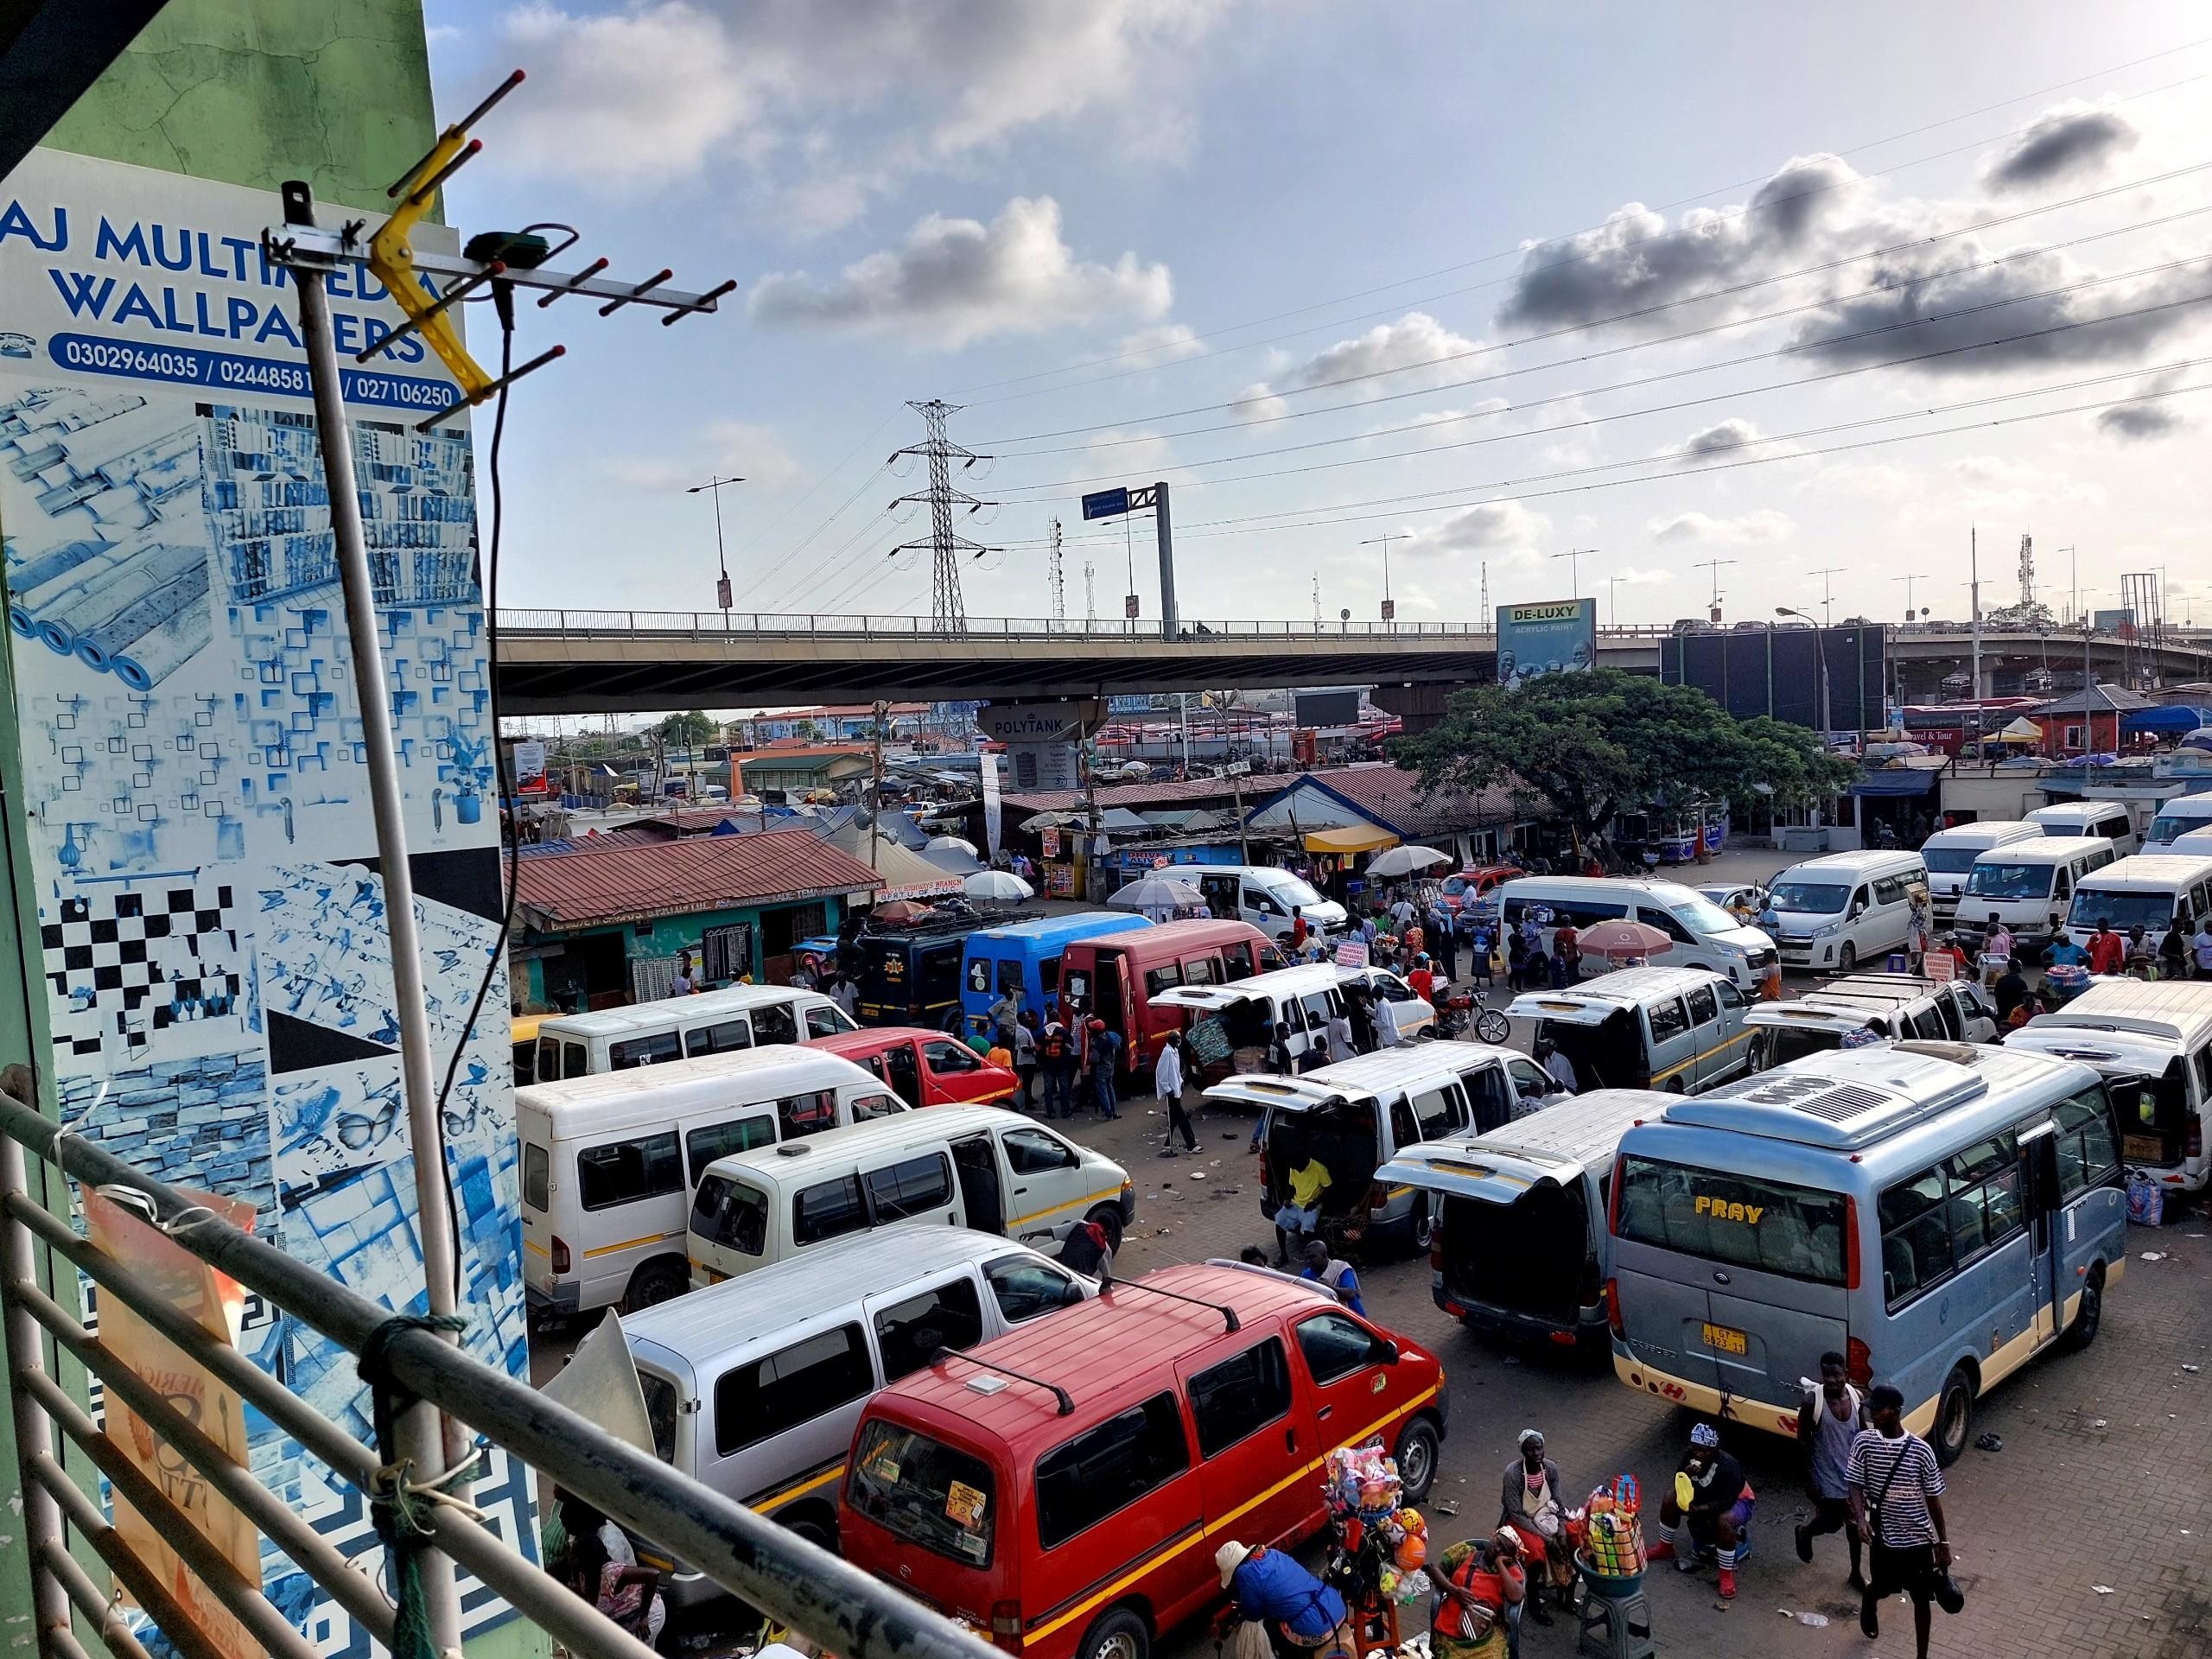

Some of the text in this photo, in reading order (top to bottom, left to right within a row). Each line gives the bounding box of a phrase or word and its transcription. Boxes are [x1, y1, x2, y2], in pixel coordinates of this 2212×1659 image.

[0, 199, 68, 252] AJ
[48, 269, 424, 362] WALLPAERS
[67, 341, 198, 378] 0302964035
[357, 378, 453, 407] 027106250
[1514, 606, 1575, 620] DE-LUXY
[1515, 626, 1549, 634] ACRYLIC
[995, 720, 1063, 734] POLYTANK
[1936, 731, 1953, 741] Tour
[935, 879, 962, 888] BRANCH
[1695, 1196, 1764, 1224] PRAY
